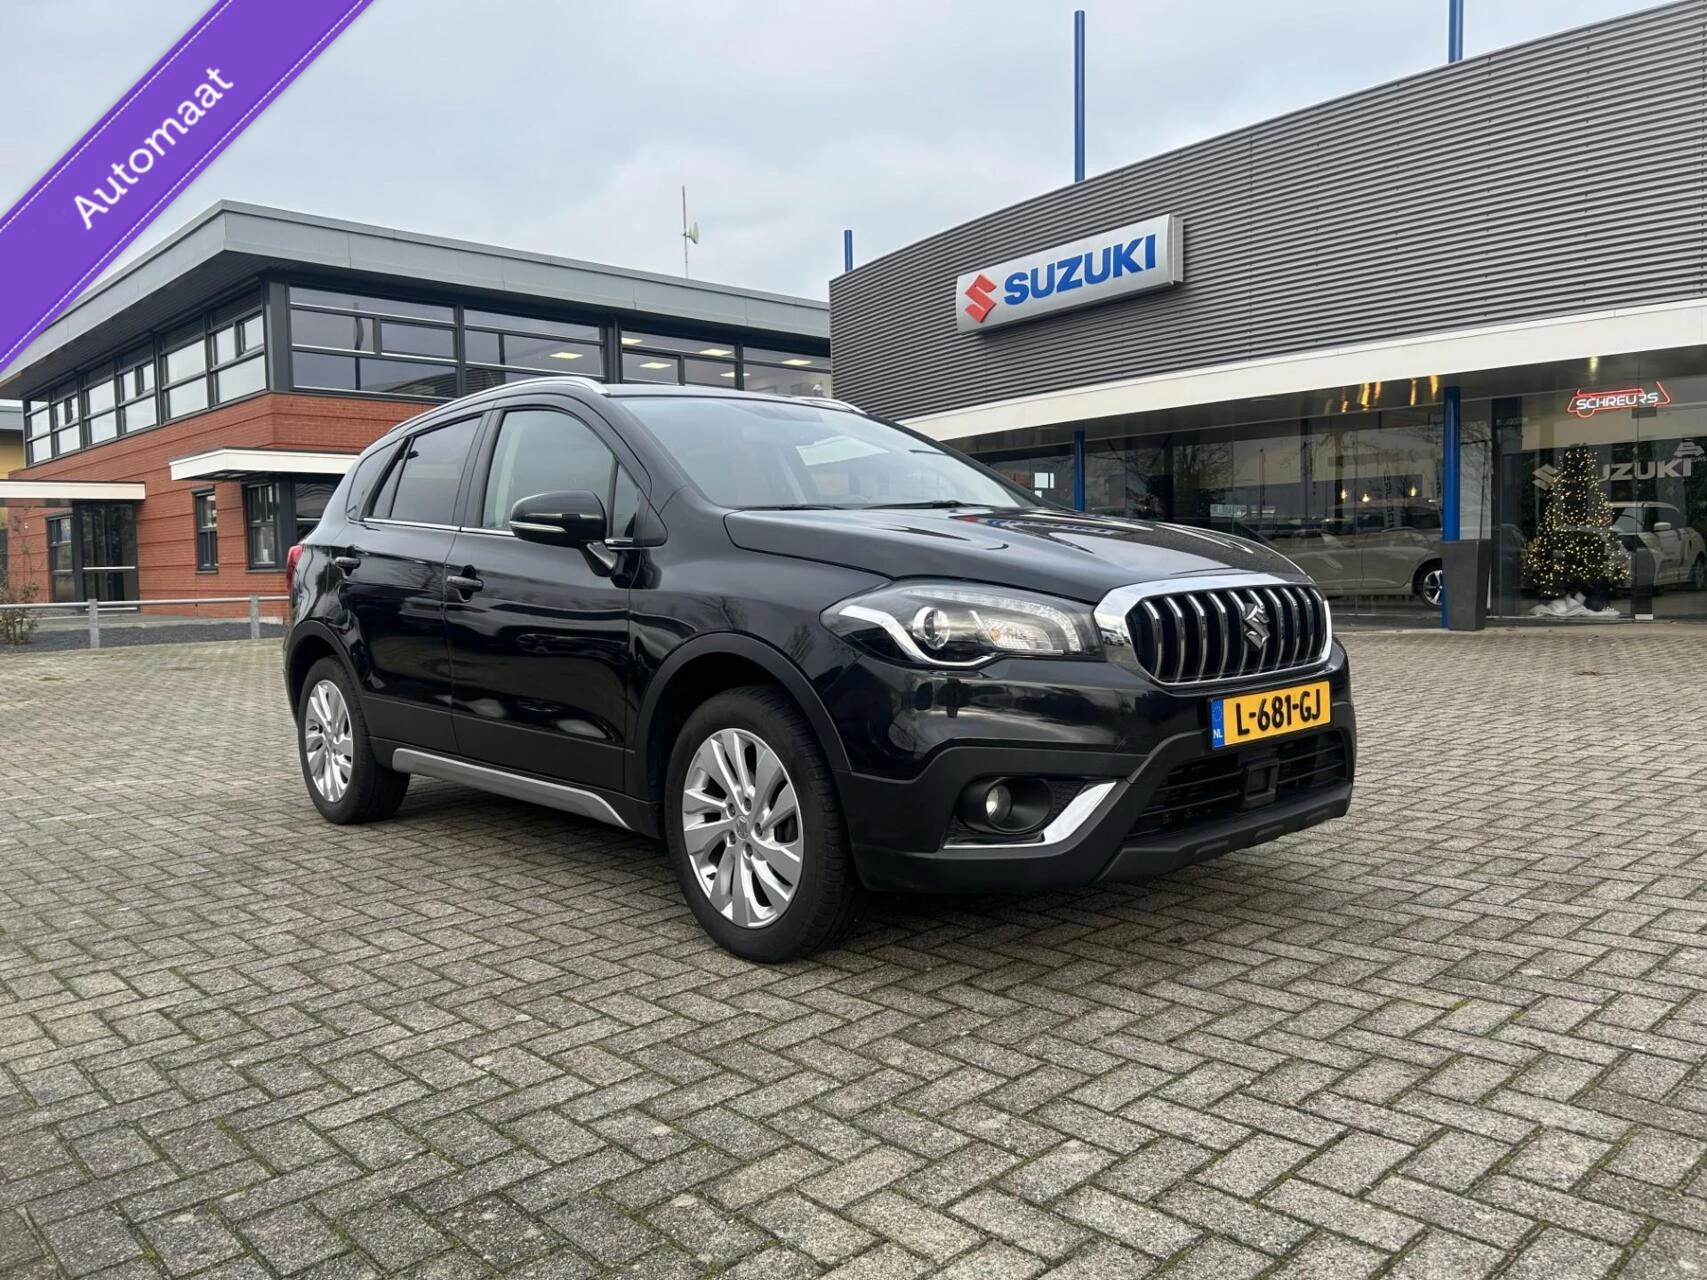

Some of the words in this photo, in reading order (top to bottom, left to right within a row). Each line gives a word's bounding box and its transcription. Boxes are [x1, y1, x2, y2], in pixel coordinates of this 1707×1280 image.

[1003, 233, 1156, 306] SUZUKI
[1575, 392, 1659, 410] SCHREURS
[1235, 688, 1321, 737] L-681-GJ
[1212, 728, 1223, 739] NL
